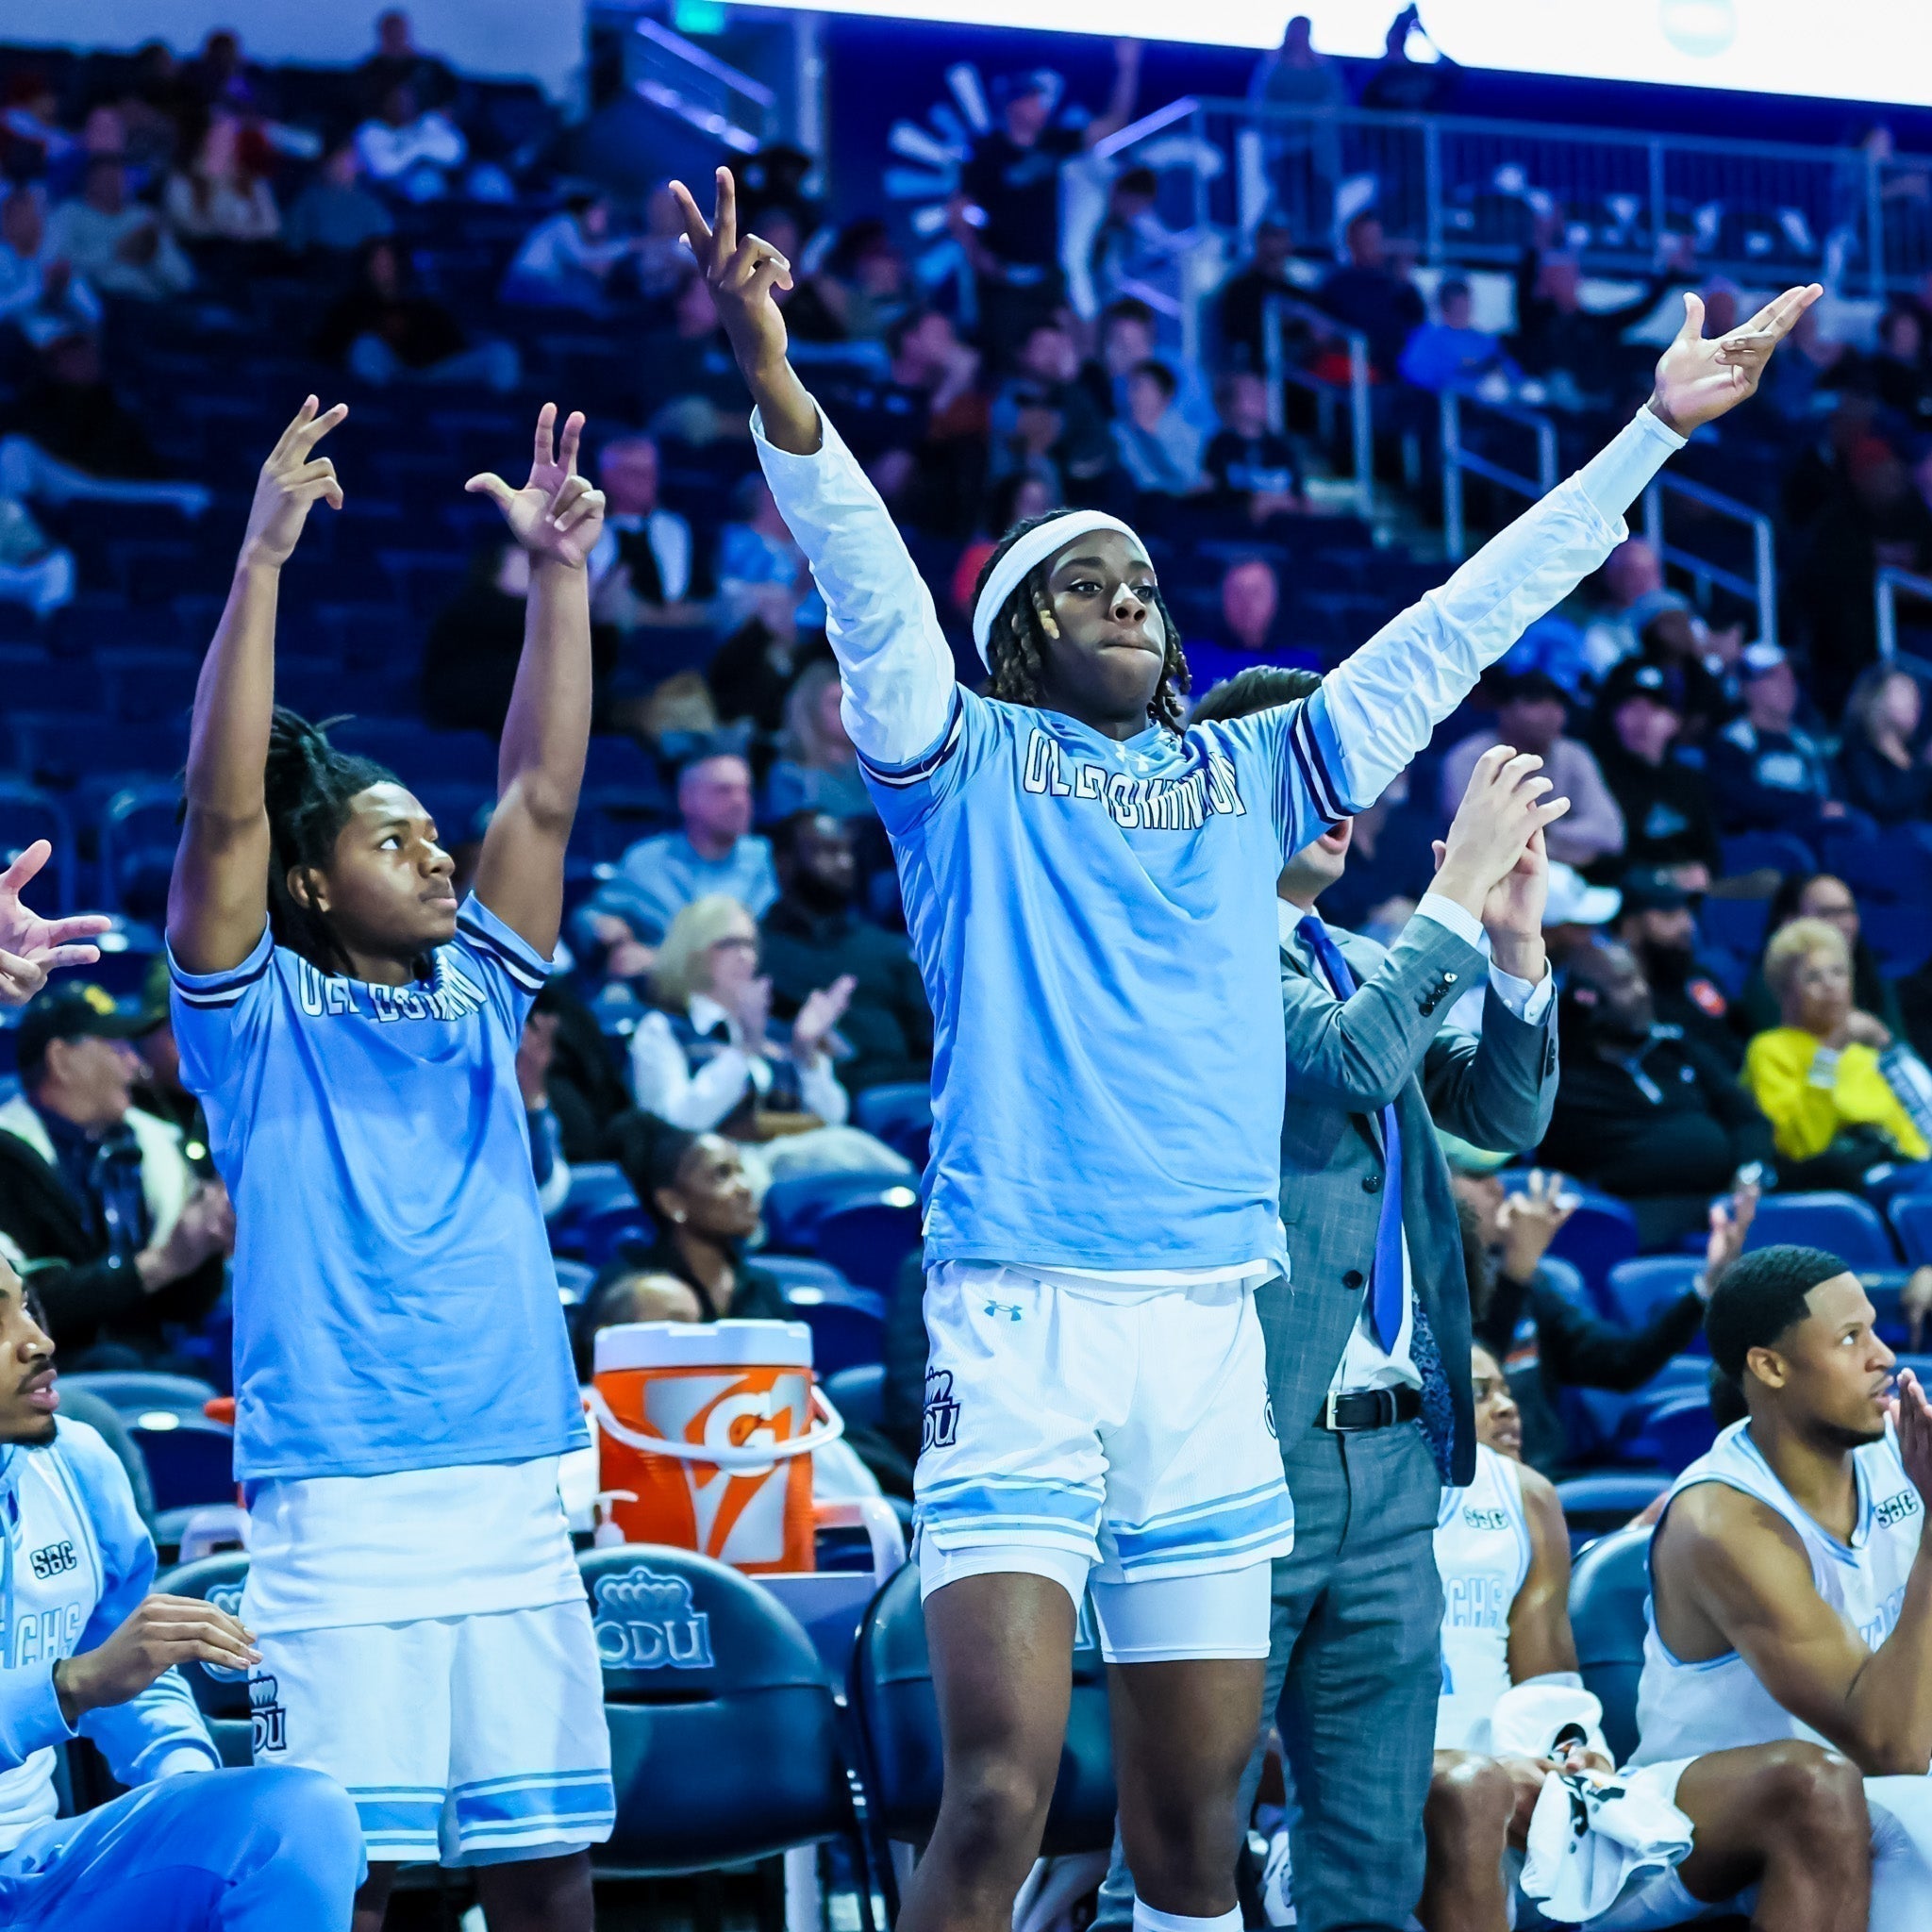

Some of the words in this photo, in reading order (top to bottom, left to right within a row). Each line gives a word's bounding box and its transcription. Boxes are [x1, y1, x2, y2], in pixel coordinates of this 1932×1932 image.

[1874, 1490, 1920, 1530] SBC
[30, 1541, 77, 1580] SBC
[594, 1620, 704, 1662] ODU
